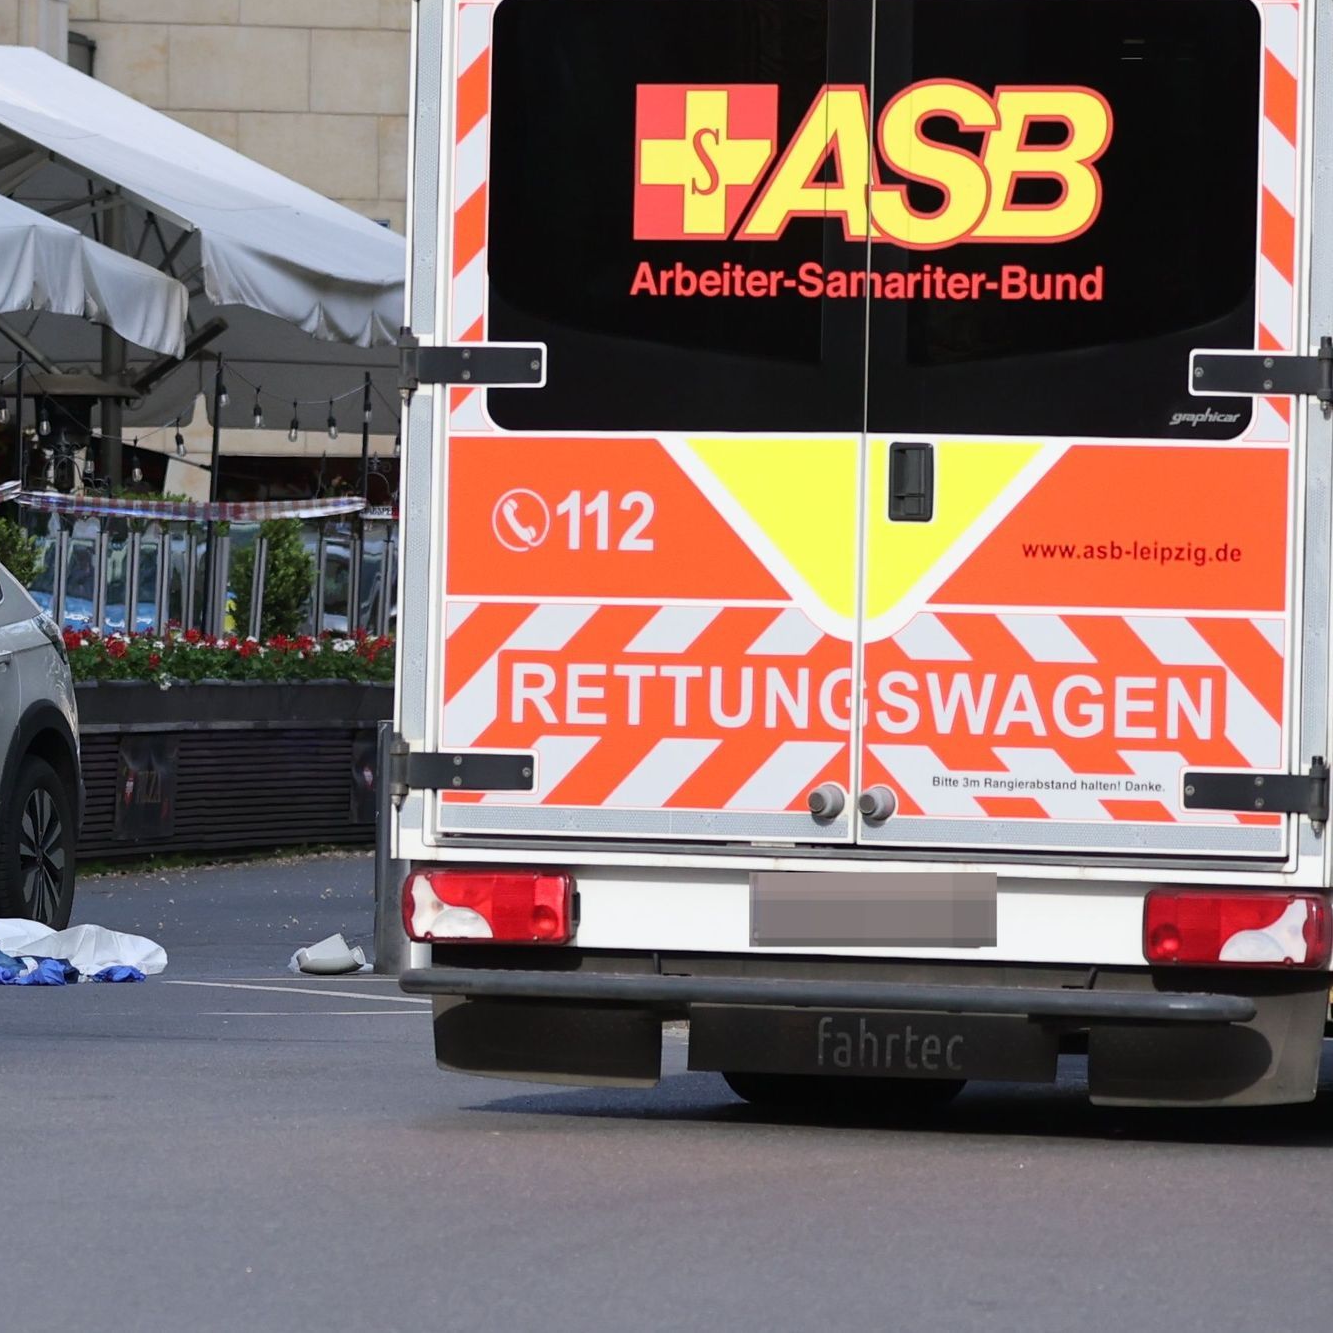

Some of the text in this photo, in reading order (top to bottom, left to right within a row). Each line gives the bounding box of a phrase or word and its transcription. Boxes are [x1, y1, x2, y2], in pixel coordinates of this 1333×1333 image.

[734, 78, 1114, 251] ASB
[629, 261, 1104, 302] Arbeiter-Samariter-Bund
[1169, 407, 1241, 427] graphicar
[555, 489, 656, 552] 112
[1021, 540, 1242, 567] www.asb-leipzig.de
[510, 661, 1215, 742] RETTUNGSWAGEN
[932, 776, 1166, 793] Bitte 3m Rangierabstand halten! Danke.
[817, 1016, 964, 1071] fahrtec
